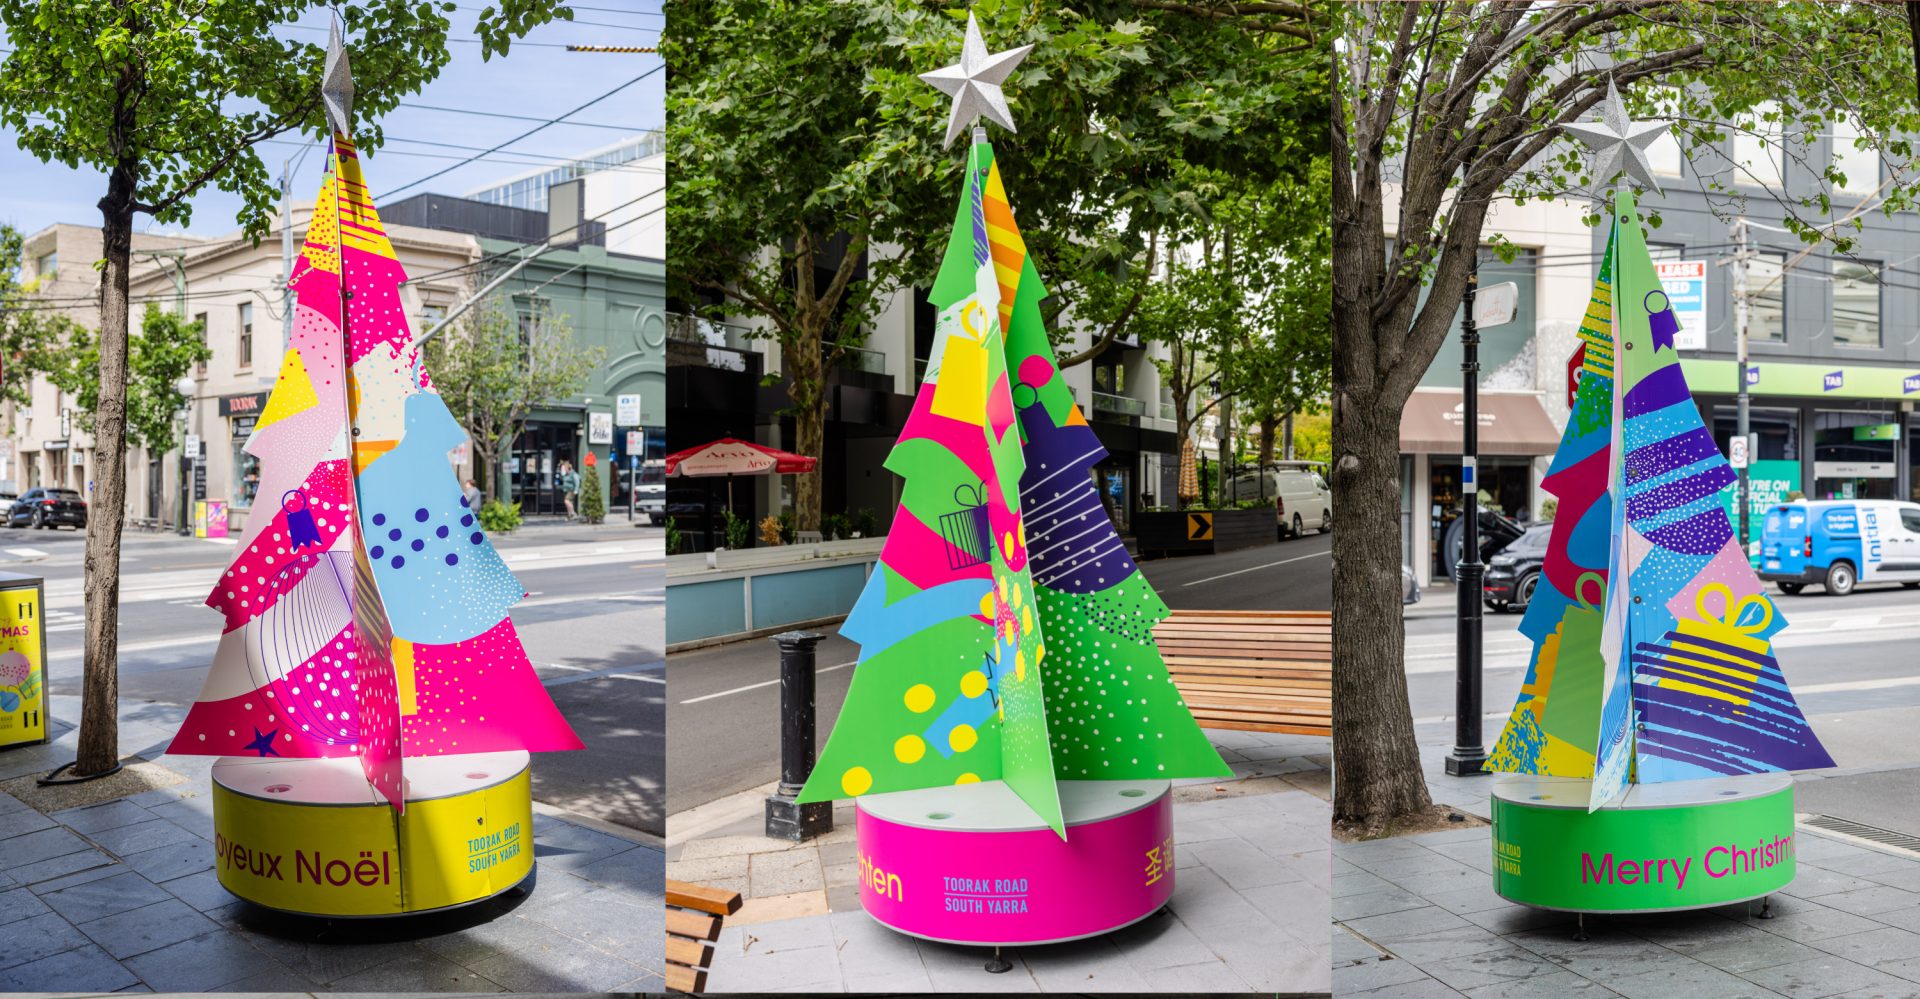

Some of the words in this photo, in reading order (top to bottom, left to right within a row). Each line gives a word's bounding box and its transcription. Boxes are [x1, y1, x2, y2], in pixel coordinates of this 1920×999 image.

[1657, 264, 1700, 277] LEASE
[1747, 372, 1758, 383] AB
[1825, 375, 1842, 387] TAB
[706, 451, 755, 459] Arvo
[1733, 446, 1744, 457] 40
[747, 458, 771, 468] Arvo
[1772, 480, 1790, 491] ON
[1862, 508, 1882, 562] Initial
[0, 625, 29, 638] MAS
[468, 832, 501, 853] TOORAK
[504, 822, 520, 841] ROAD
[216, 832, 284, 881] oyeux
[296, 850, 390, 887] Noël
[469, 853, 498, 873] SOUTH
[500, 842, 520, 863] YARRA
[1581, 852, 1692, 890] Merry
[944, 877, 990, 893] TOORAK
[995, 878, 1028, 893] ROAD
[945, 897, 983, 914] SOUTH
[988, 899, 1028, 914] YARRA
